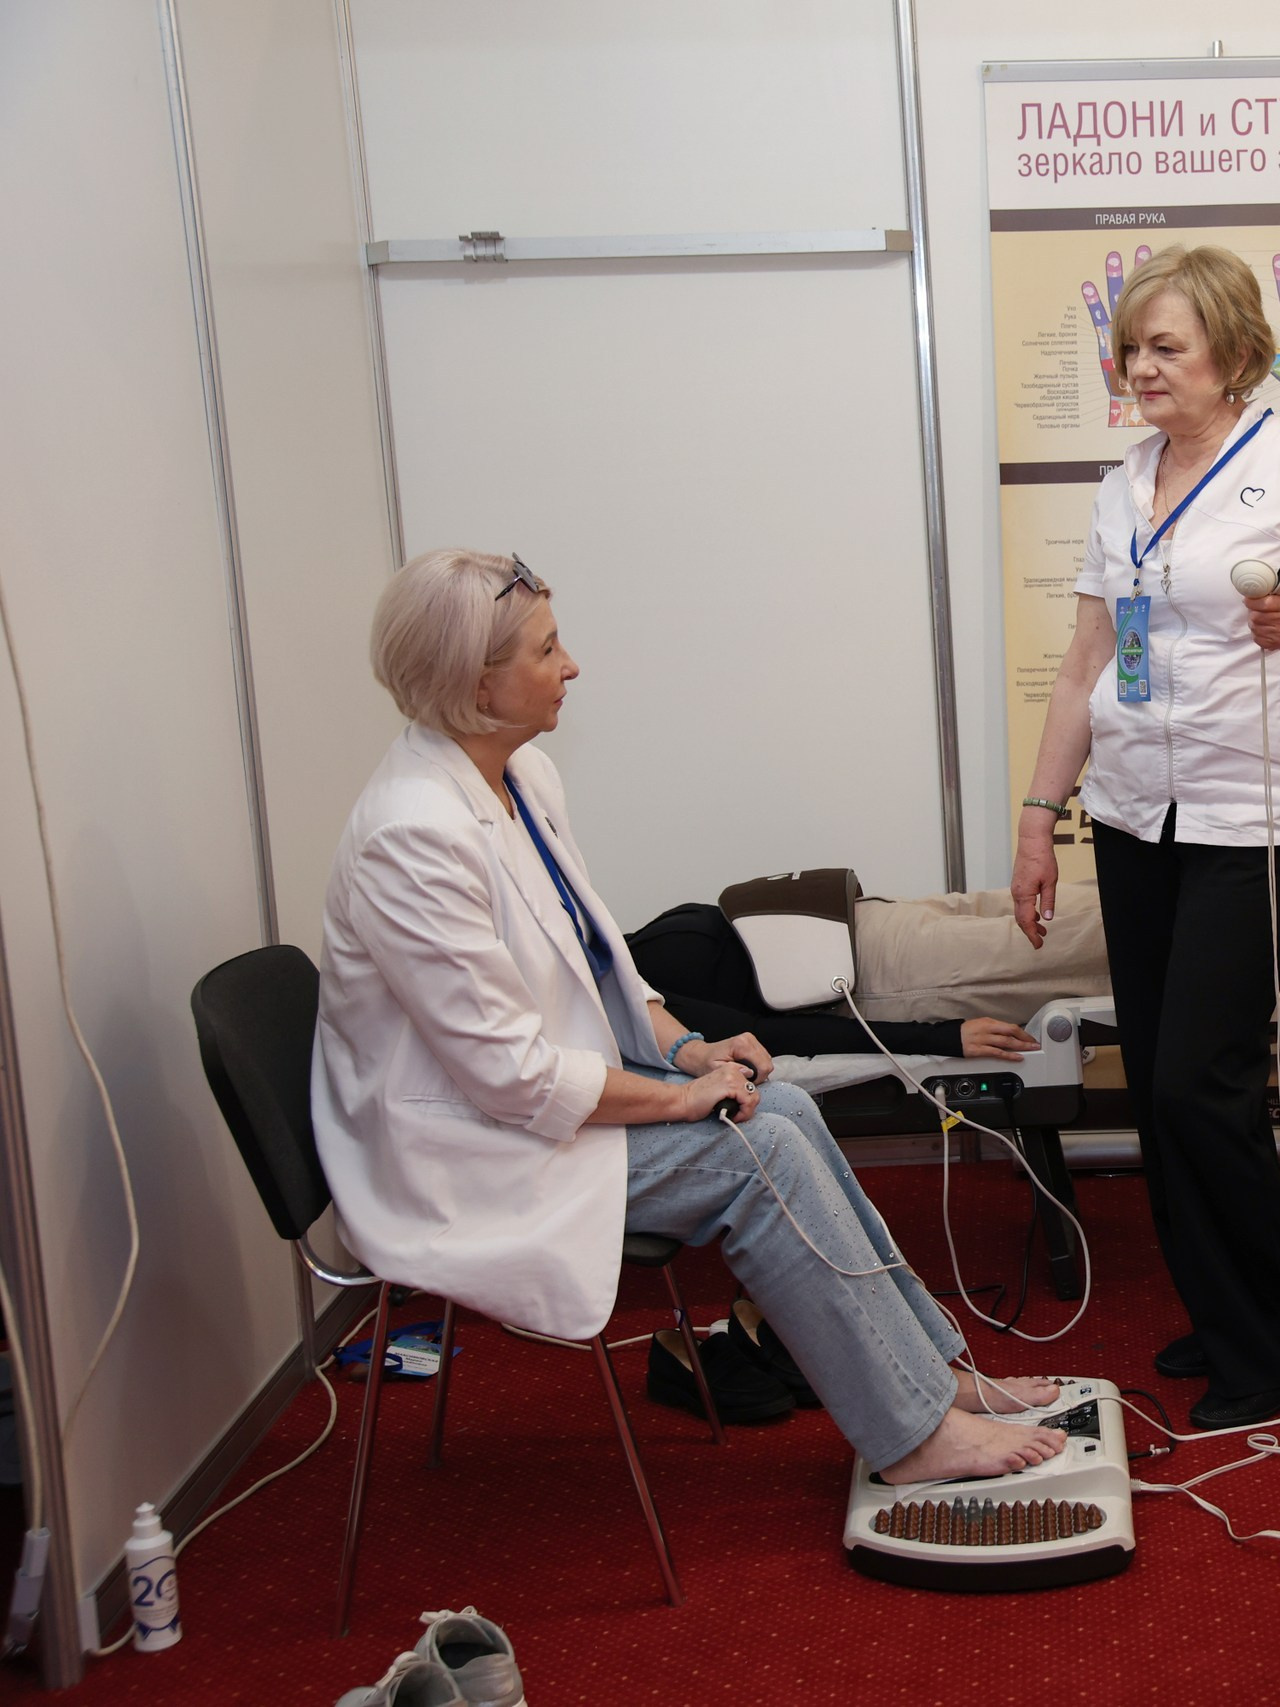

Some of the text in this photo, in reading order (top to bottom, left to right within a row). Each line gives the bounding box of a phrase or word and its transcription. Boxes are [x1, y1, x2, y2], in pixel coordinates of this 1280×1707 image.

[1017, 101, 1184, 146] ЛАДОНИ
[1200, 112, 1215, 136] и
[1017, 151, 1142, 182] зеркало
[1155, 147, 1266, 174] вашего
[1095, 213, 1165, 224] ПРАВАЯ РУКА
